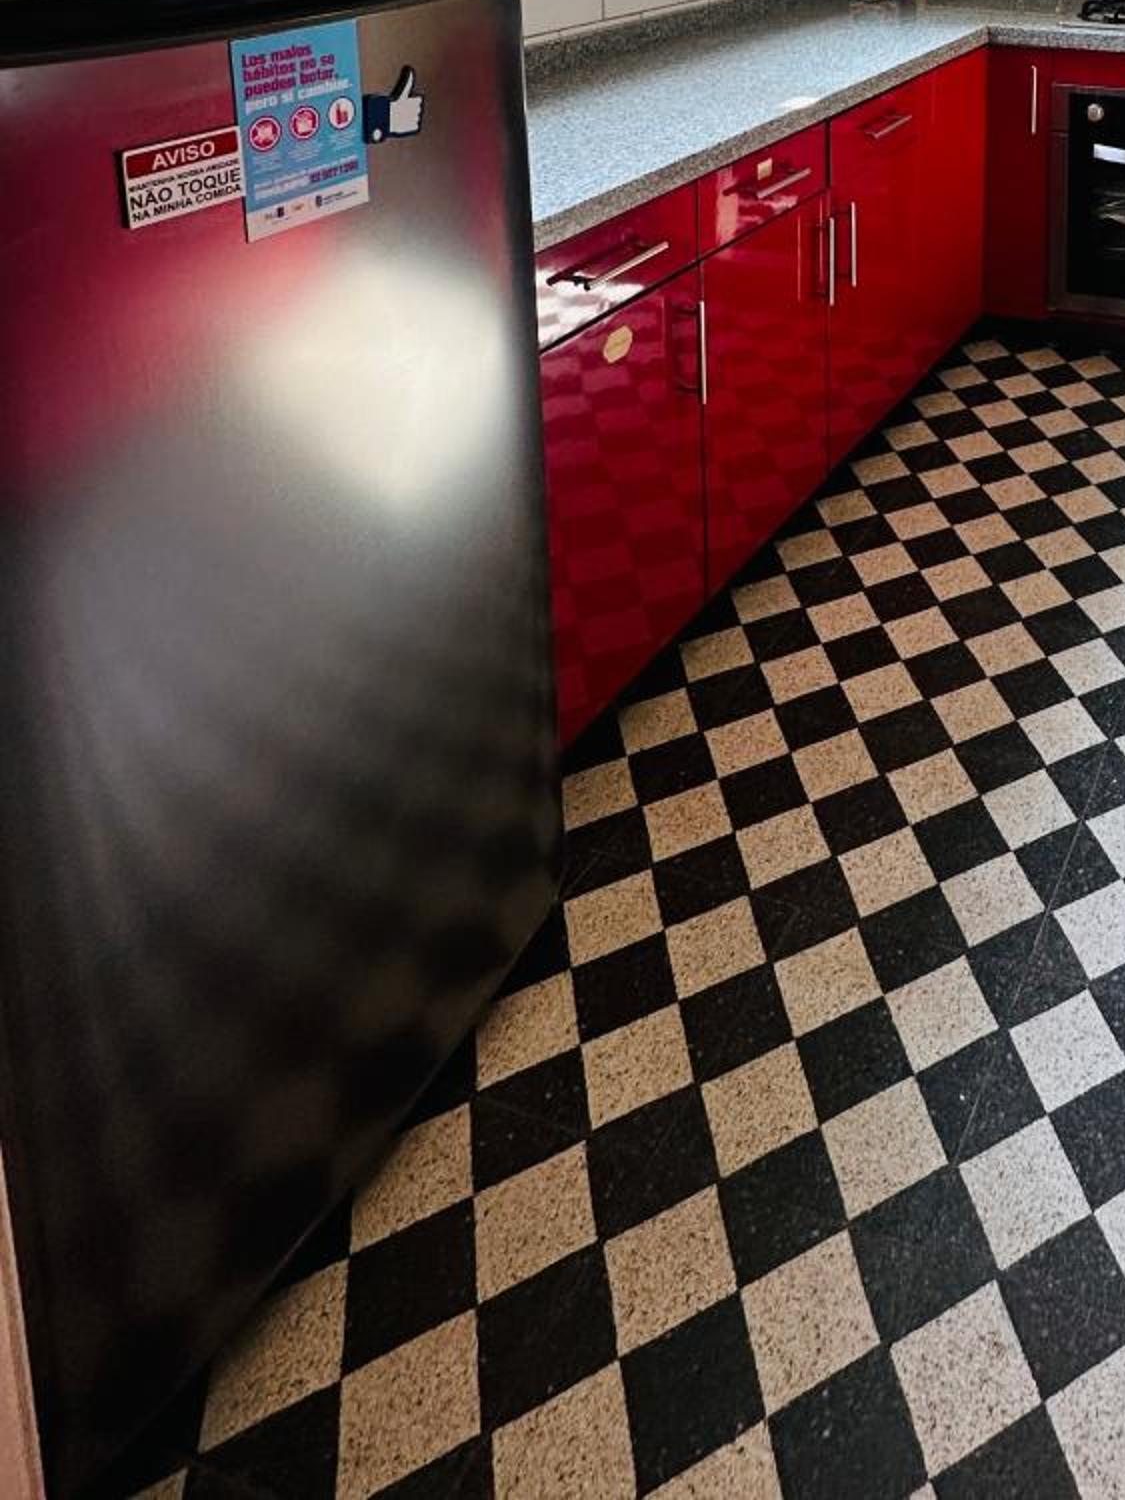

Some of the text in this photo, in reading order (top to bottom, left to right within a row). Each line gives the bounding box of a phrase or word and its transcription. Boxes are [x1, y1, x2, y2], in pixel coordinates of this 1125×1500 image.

[242, 43, 313, 68] Los malos
[300, 58, 317, 70] no
[319, 53, 335, 66] se
[152, 141, 215, 170] AVISO
[130, 187, 173, 211] NÃO
[177, 168, 241, 196] TOQUE
[132, 183, 241, 222] NA MINHA COMIDA
